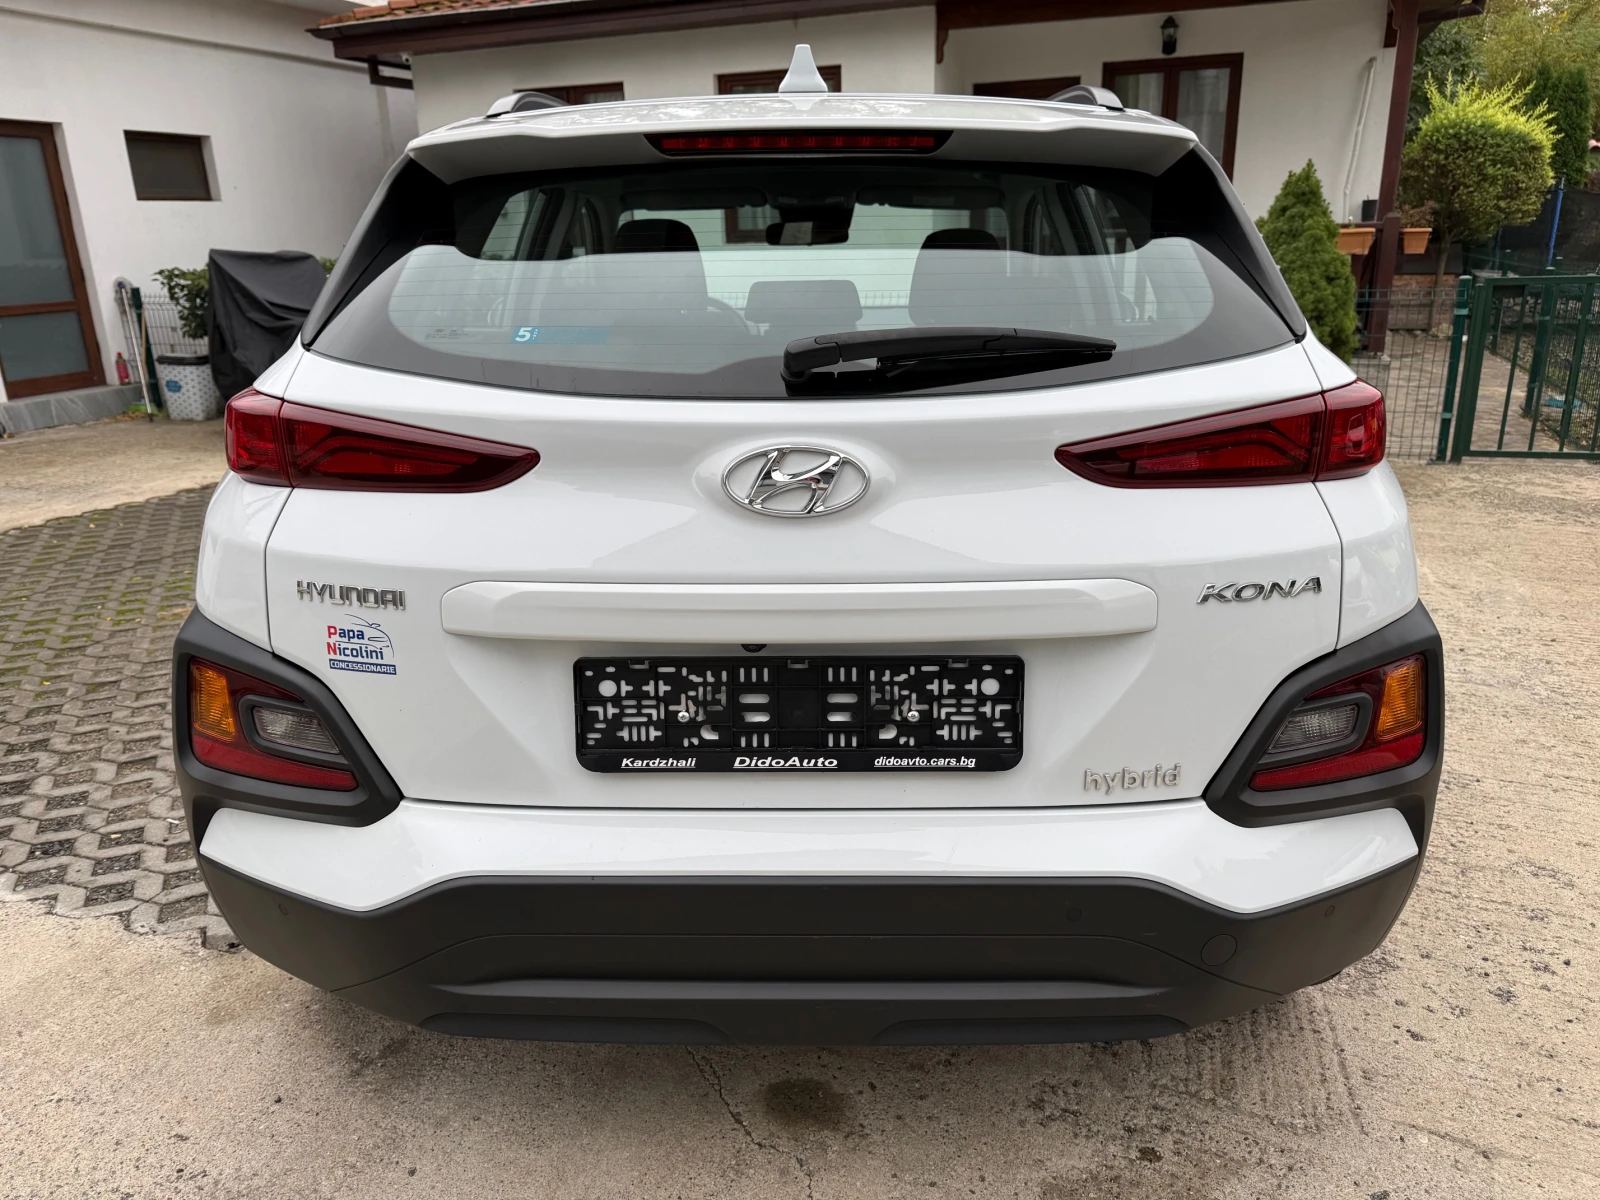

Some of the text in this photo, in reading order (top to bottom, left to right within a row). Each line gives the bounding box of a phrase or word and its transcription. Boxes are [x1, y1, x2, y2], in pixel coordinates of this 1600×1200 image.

[514, 327, 533, 342] 5
[296, 580, 406, 610] HYUNDAI
[1196, 576, 1322, 604] KONA
[327, 625, 365, 641] Papa
[326, 642, 384, 660] Nicolini
[330, 660, 396, 674] CONCESSIONARIE
[621, 757, 697, 768] Kardzhali
[733, 756, 839, 768] DidoAuto
[874, 756, 976, 767] didoavto.cars.bg
[1084, 763, 1182, 794] hybrid
